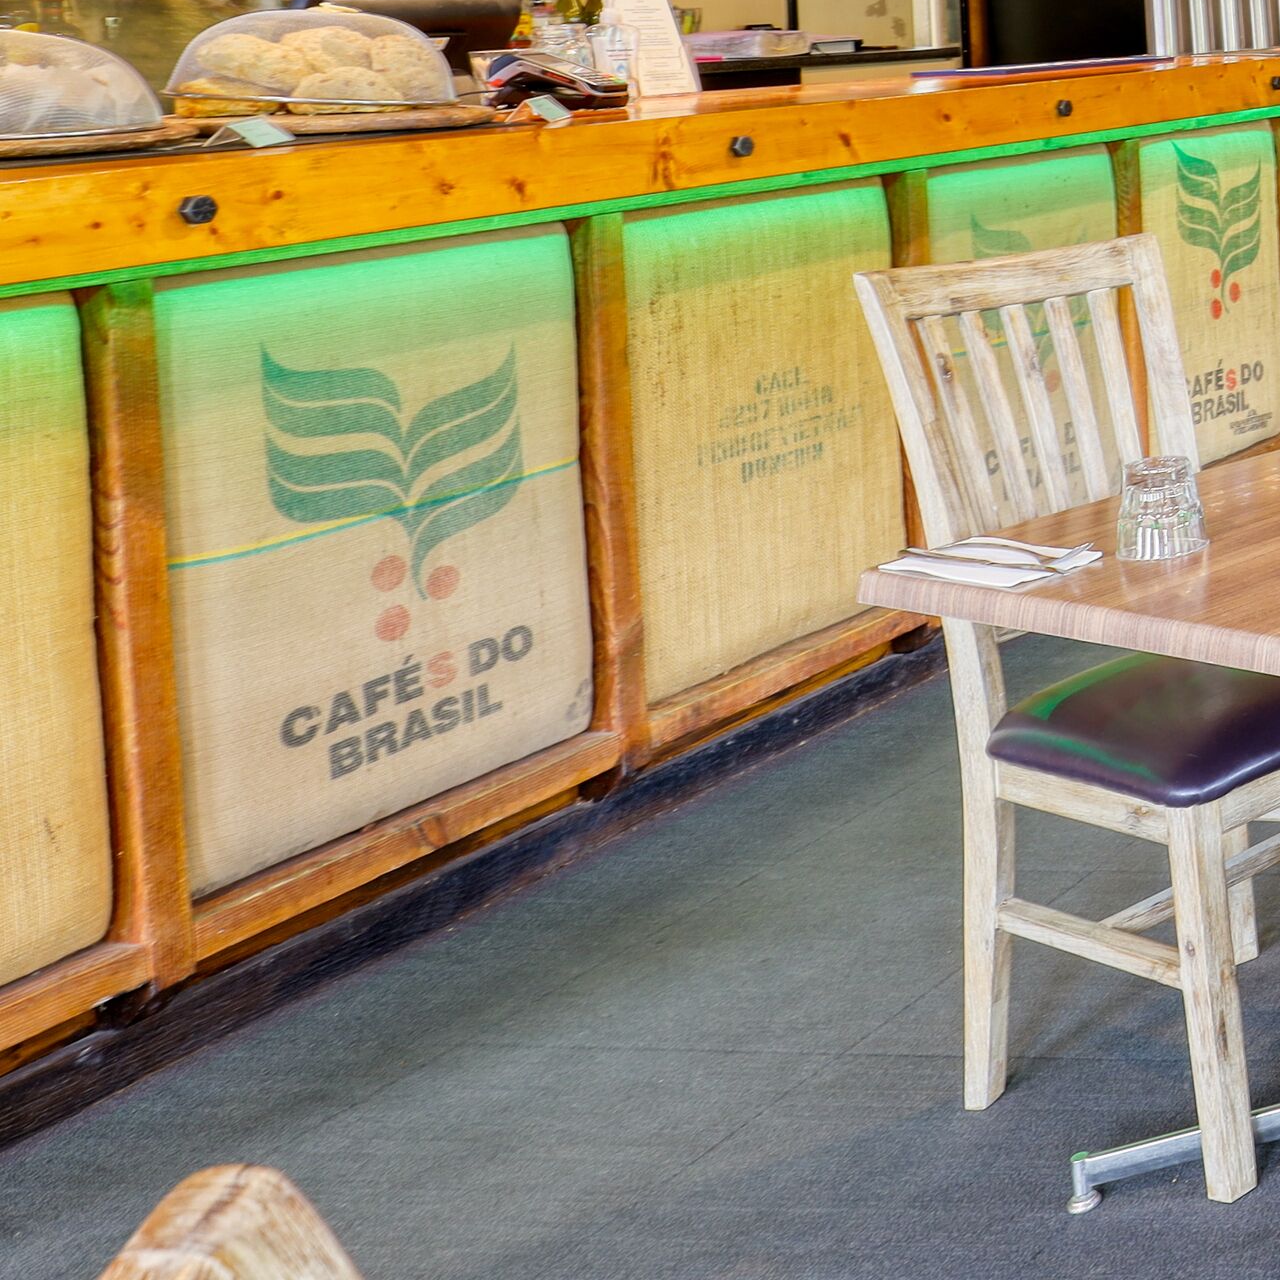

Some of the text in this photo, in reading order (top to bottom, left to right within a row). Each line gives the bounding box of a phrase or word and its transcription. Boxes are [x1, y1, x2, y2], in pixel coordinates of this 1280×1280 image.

[1190, 389, 1249, 426] BRASIL
[1240, 360, 1264, 386] DO
[279, 623, 535, 749] CAFÉS DO
[329, 679, 505, 781] BRASIL
